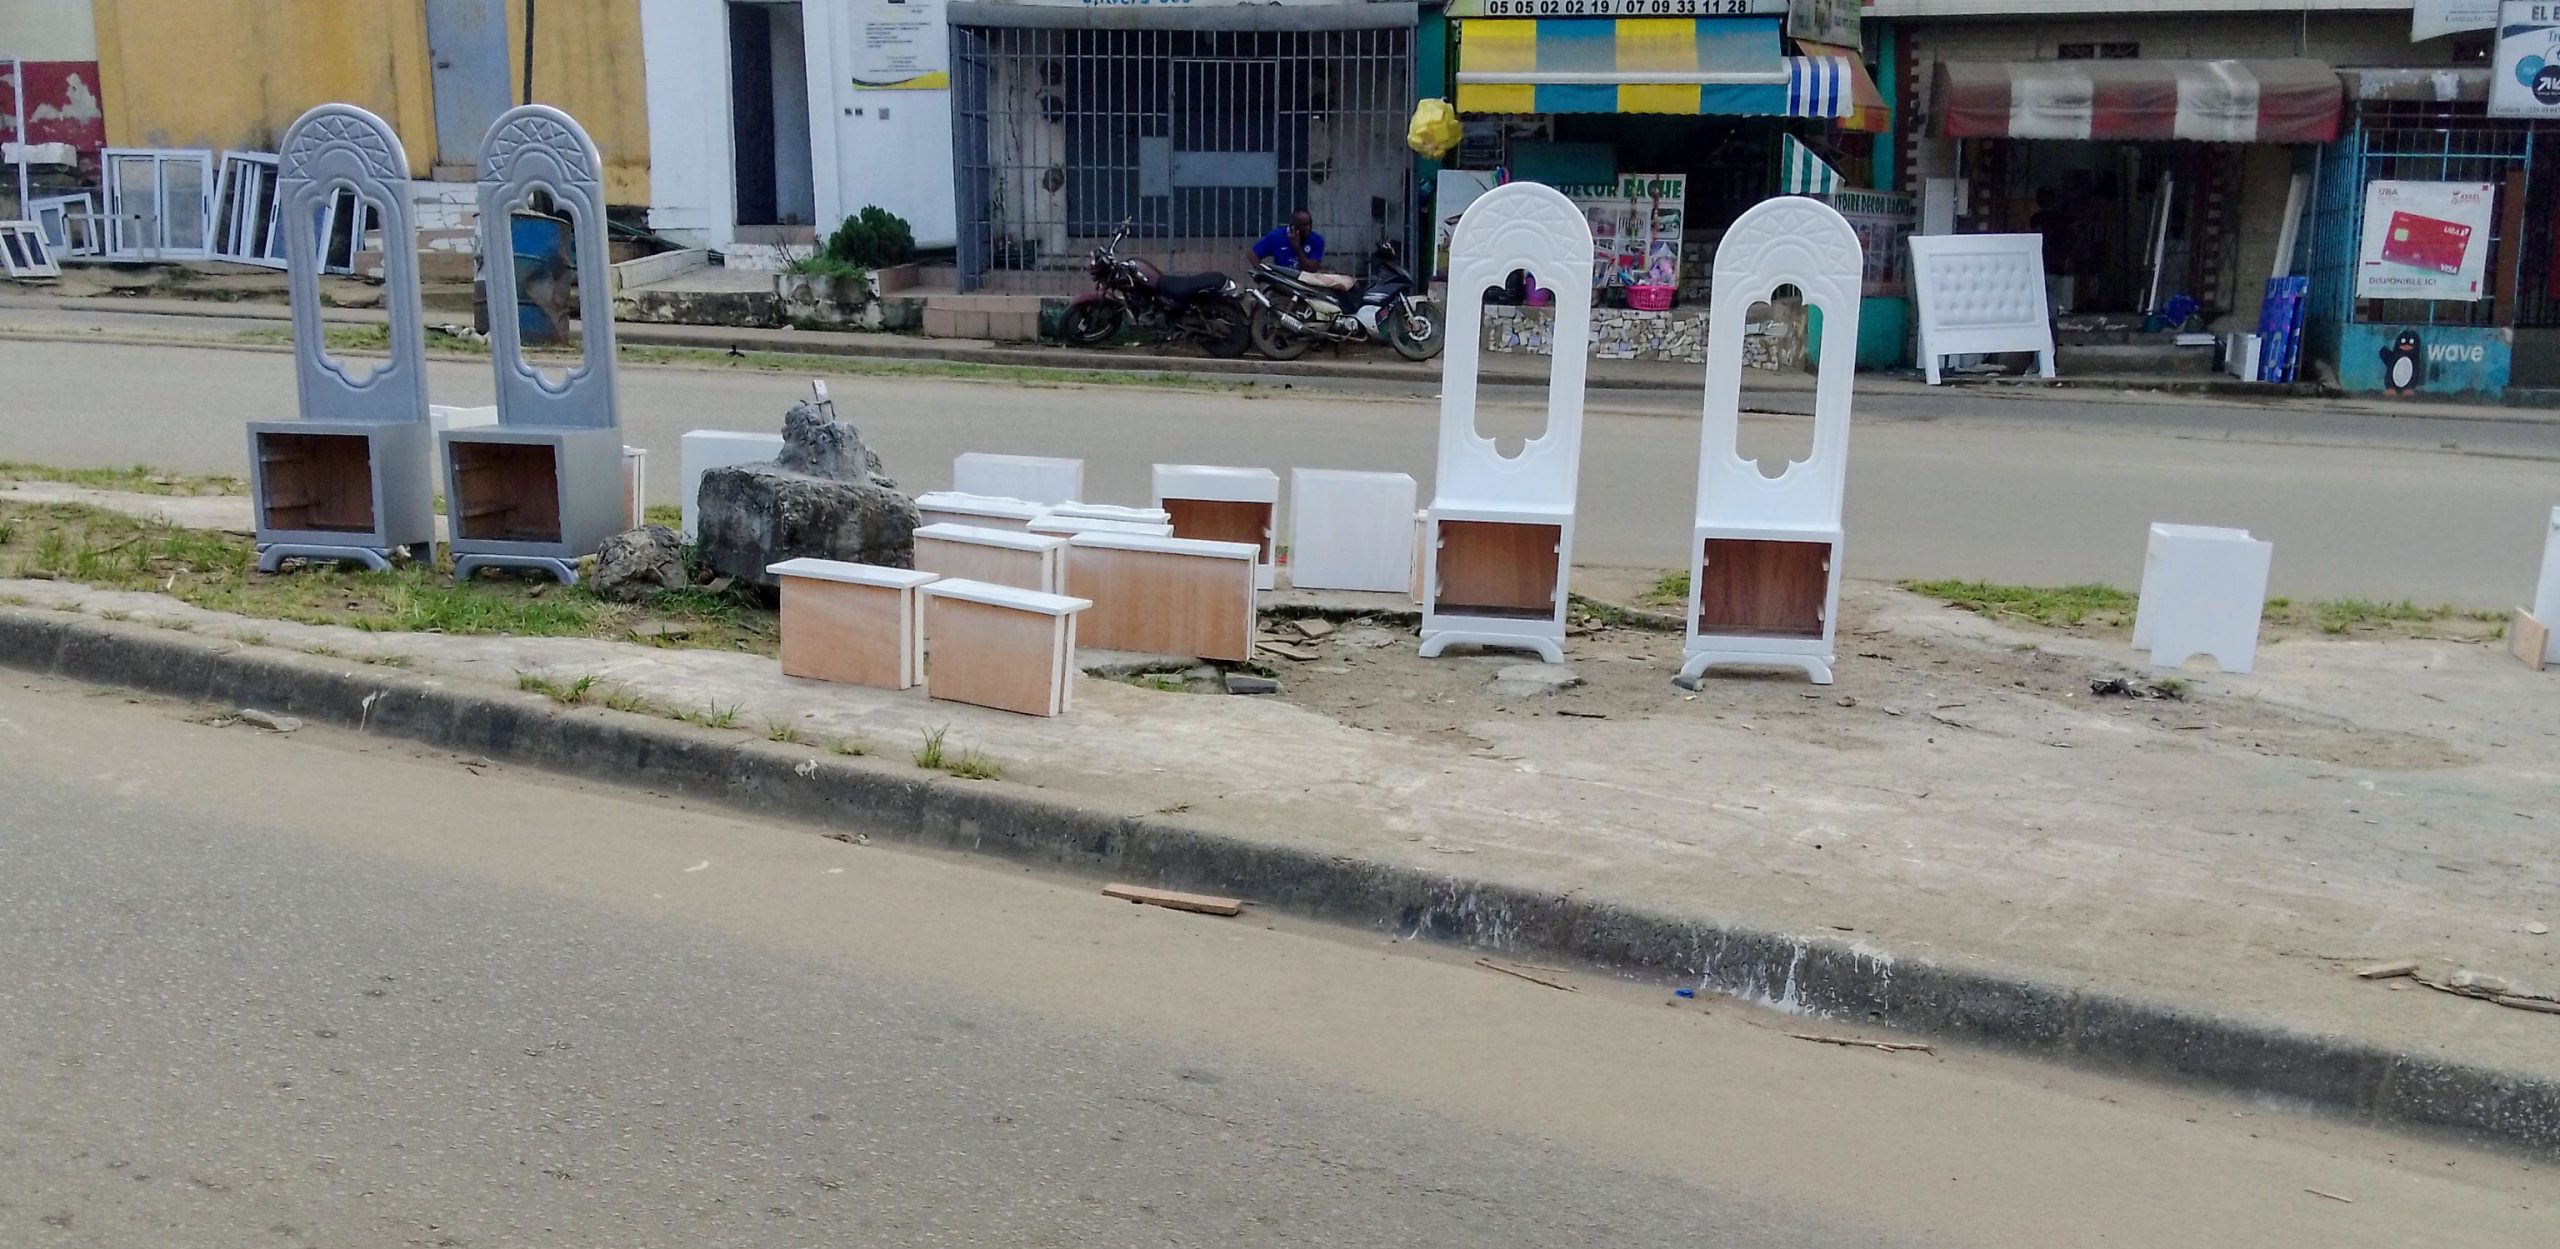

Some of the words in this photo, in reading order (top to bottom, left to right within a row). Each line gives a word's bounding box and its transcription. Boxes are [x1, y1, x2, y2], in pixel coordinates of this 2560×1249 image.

[1489, 0, 1509, 14] 05
[1515, 0, 1534, 14] 05
[1540, 0, 1559, 14] 02
[1565, 0, 1584, 14] 02
[1590, 0, 1610, 14] 19
[1625, 0, 1645, 14] 07
[1651, 0, 1670, 14] 09
[1676, 0, 1696, 14] 33
[1702, 0, 1721, 14] 11
[1727, 0, 1747, 14] 28
[2531, 6, 2548, 20] EL
[1623, 178, 1682, 199] BACHE
[2378, 188, 2399, 196] UBA
[2368, 277, 2423, 286] DISPONIBLE
[2427, 344, 2485, 362] wave
